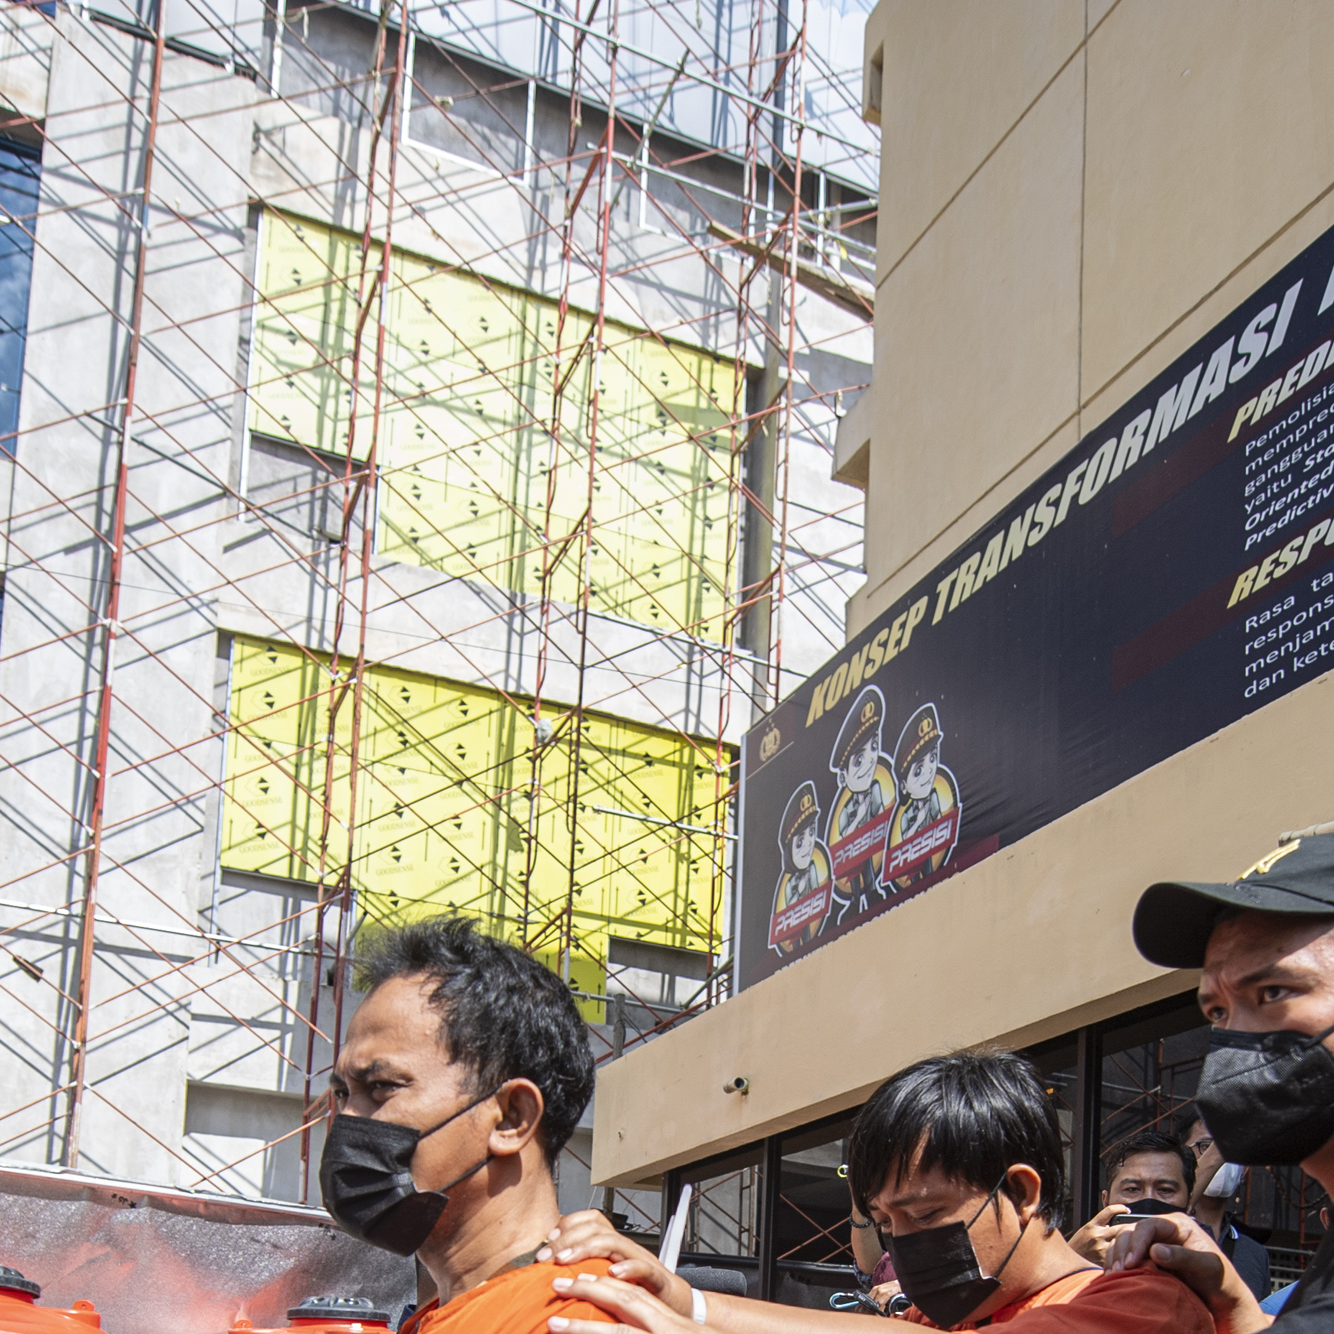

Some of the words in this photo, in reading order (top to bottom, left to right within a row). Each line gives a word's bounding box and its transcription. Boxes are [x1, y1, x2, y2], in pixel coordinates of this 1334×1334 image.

[806, 595, 928, 727] KONSEP
[932, 278, 1304, 625] TRANSFORMASI
[1244, 473, 1292, 514] yaitu
[1244, 459, 1334, 531] Oriented
[1244, 595, 1296, 634] Rasa
[1244, 668, 1286, 699] dan
[833, 820, 889, 868] PRESISI
[889, 818, 952, 873] PRESISI
[775, 889, 827, 936] PRESISI
